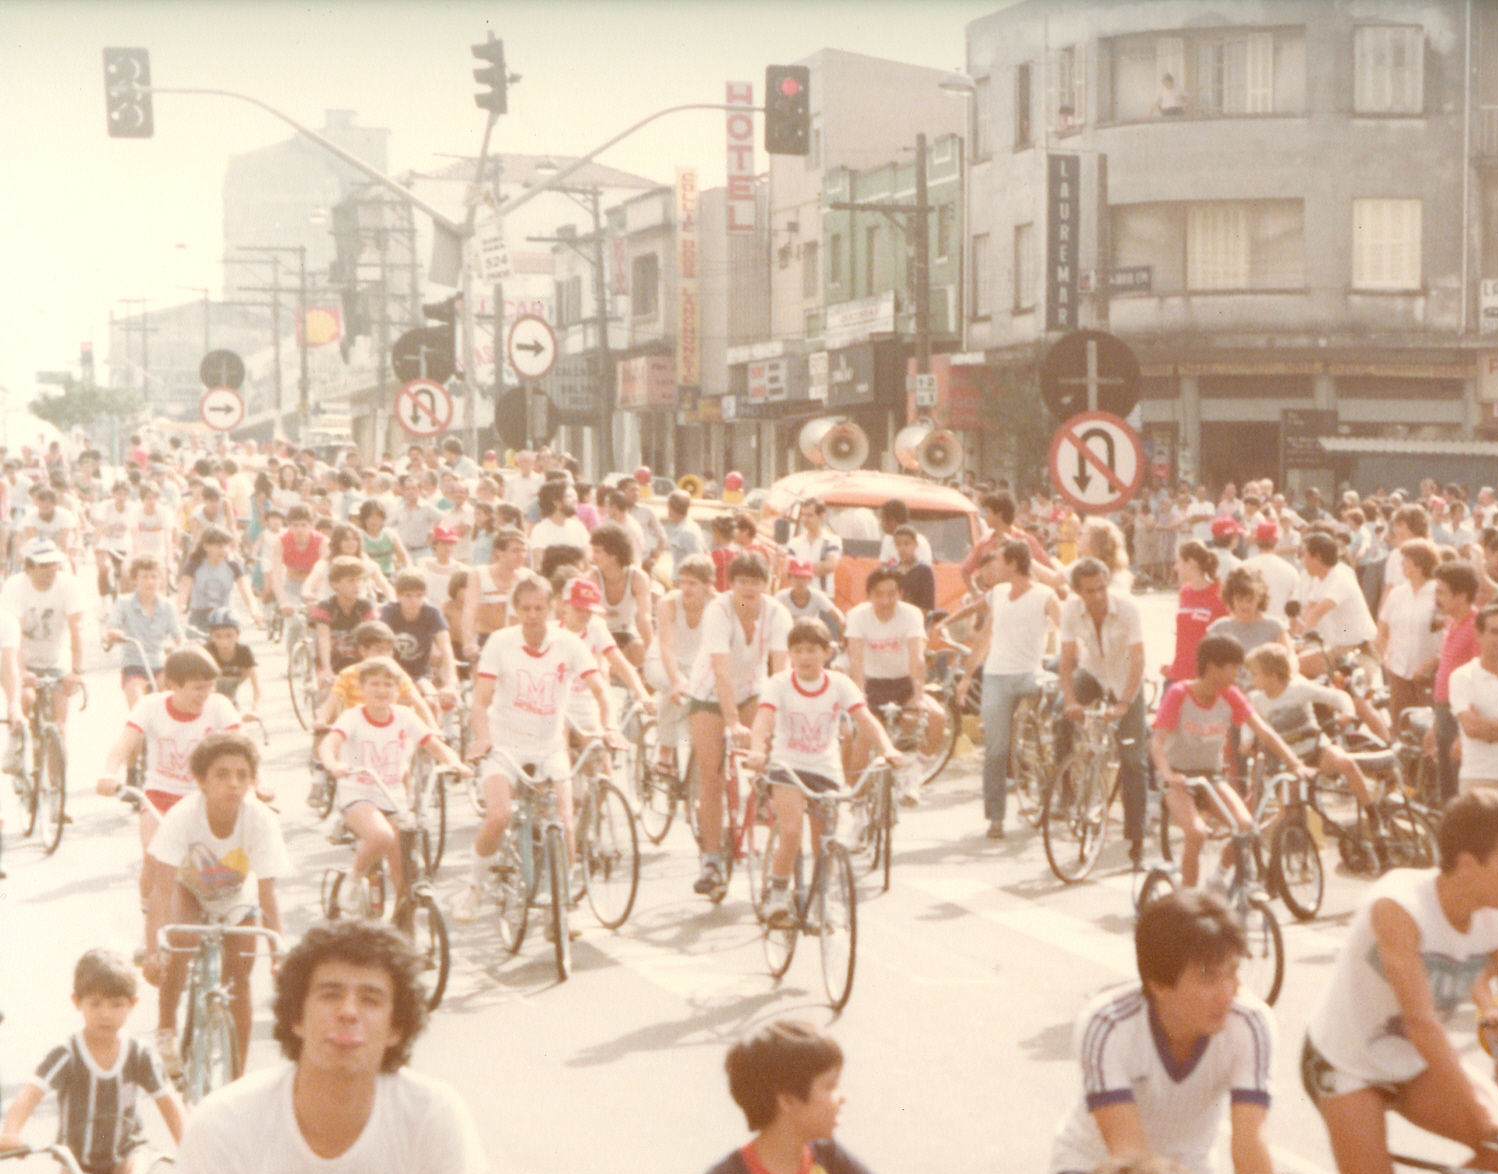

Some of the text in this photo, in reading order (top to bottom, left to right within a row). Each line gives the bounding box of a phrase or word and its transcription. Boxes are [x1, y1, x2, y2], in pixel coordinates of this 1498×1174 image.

[726, 84, 755, 231] HOTEL
[1056, 159, 1070, 325] LAUREMAR
[515, 668, 558, 707] M
